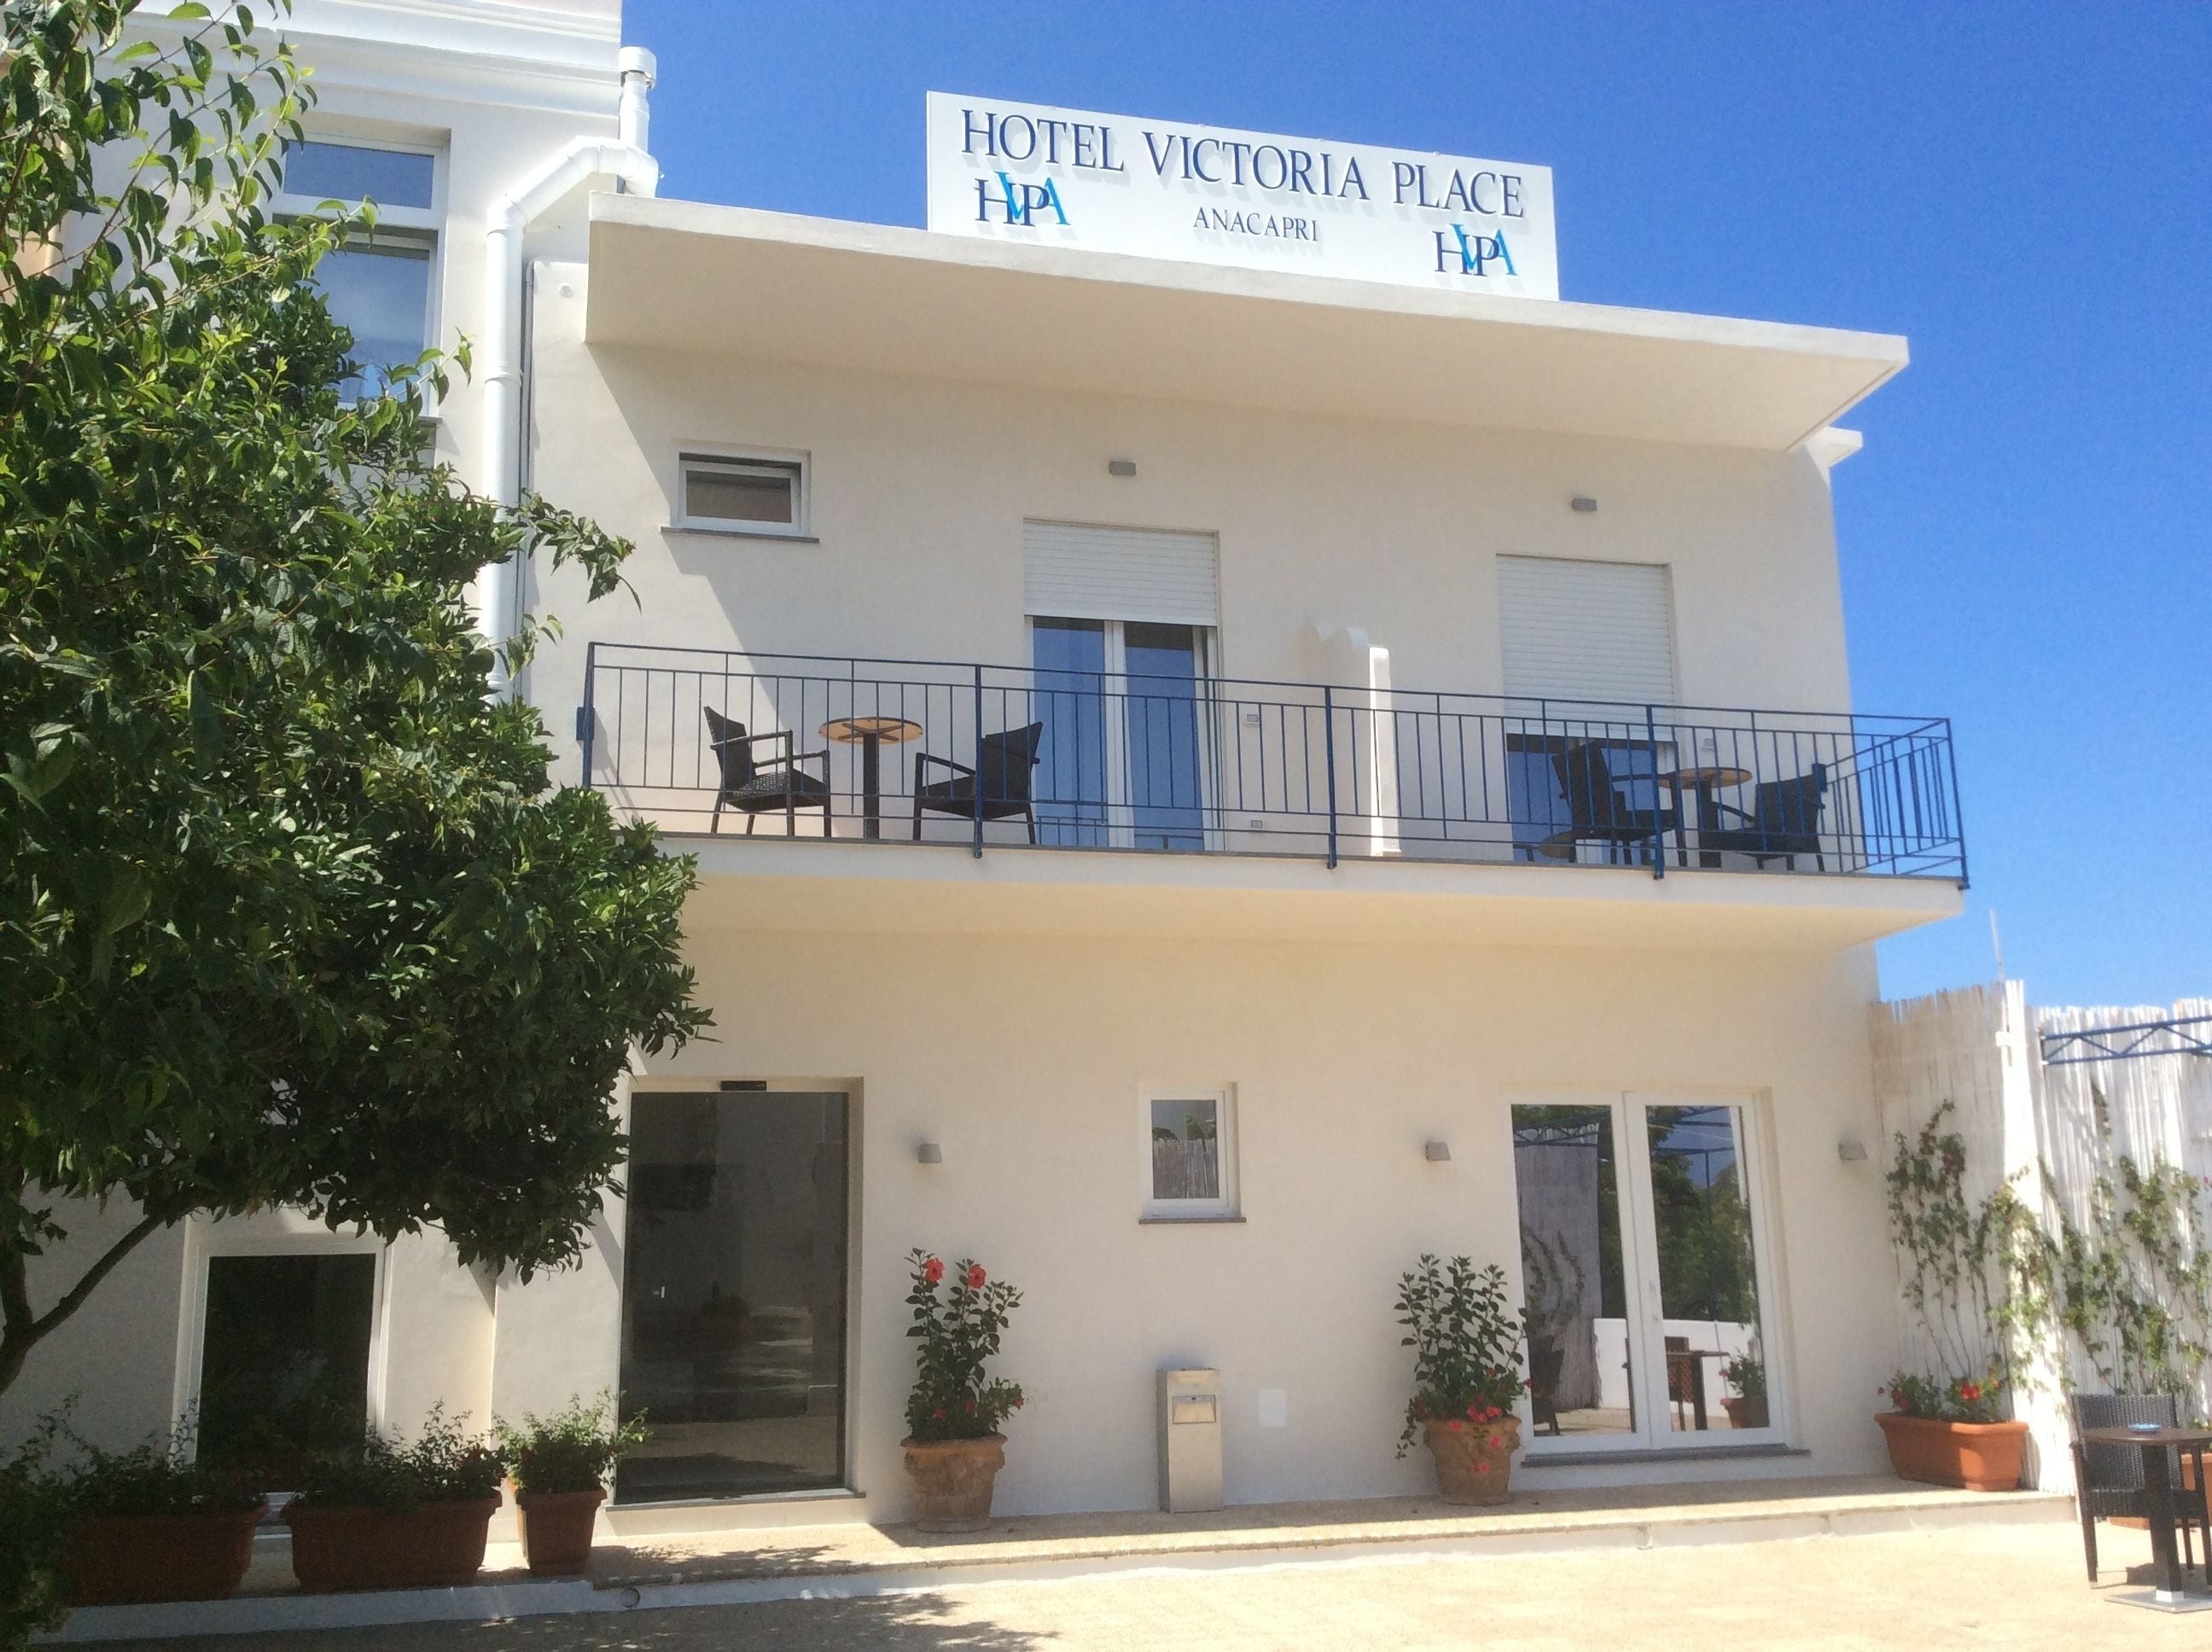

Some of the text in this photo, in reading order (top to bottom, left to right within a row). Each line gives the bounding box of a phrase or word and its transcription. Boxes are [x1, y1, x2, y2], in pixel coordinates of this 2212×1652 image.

[961, 109, 1523, 218] HOTEL VICTORIA PLACE
[1193, 206, 1318, 241] ANACAPRI
